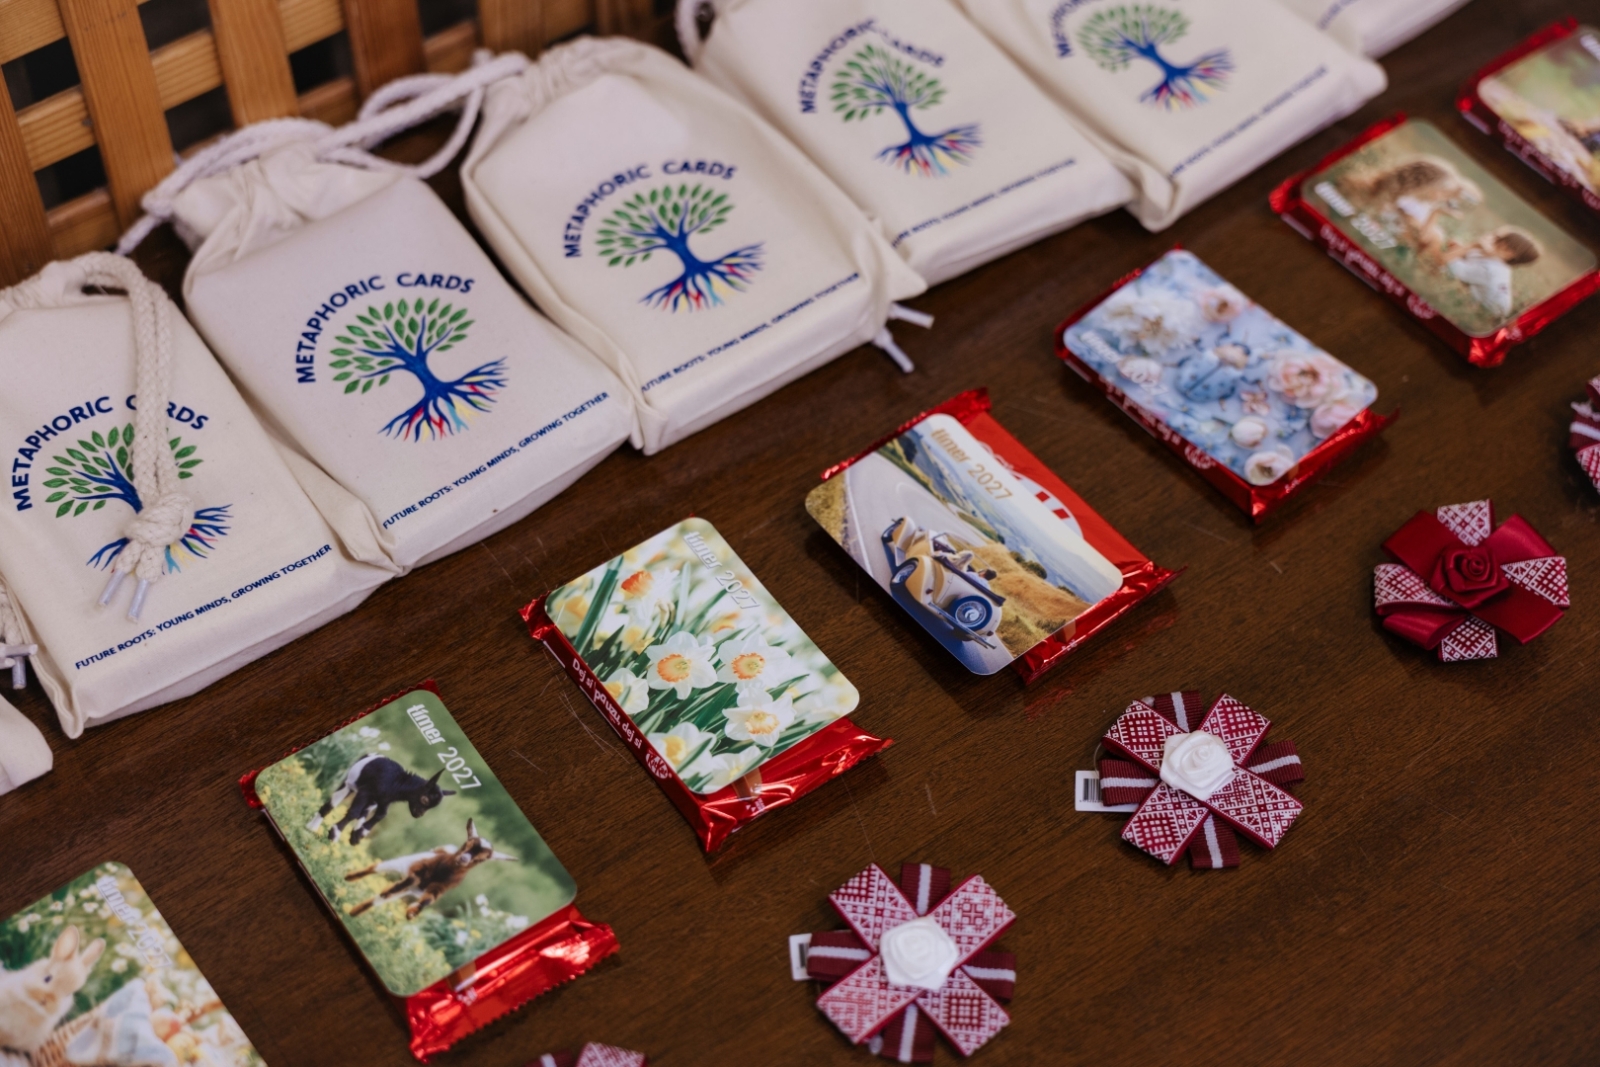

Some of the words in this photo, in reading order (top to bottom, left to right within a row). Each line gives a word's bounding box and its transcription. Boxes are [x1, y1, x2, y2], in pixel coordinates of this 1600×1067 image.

[564, 164, 652, 258] METAPHORIC
[662, 159, 737, 180] CARDS
[296, 276, 385, 383] METAPHORIC
[396, 272, 475, 294] CARDS
[641, 371, 672, 392] UTURE
[707, 339, 740, 357] YOUNG
[771, 297, 814, 324] GROWING
[12, 396, 113, 511] METAPHORIC
[126, 395, 209, 430] CRDS
[382, 505, 418, 529] FUTURE
[418, 485, 454, 507] ROOTS:
[452, 466, 487, 488] YOUNG
[486, 446, 520, 468] MINDS,
[518, 419, 563, 448] GROWING
[562, 391, 609, 422] TOGETHER
[967, 463, 1013, 500] 2027
[75, 647, 116, 670] FUTURE
[117, 629, 156, 651] ROOTS:
[156, 611, 195, 635] YOUNG
[195, 596, 232, 616] MINDS,
[231, 571, 281, 599] GROWING
[280, 544, 332, 575] TOGETHER
[715, 570, 760, 609] 2027
[572, 658, 587, 683] Dej
[585, 680, 594, 688] si
[593, 689, 621, 726] pauzu,
[622, 722, 635, 742] dej
[634, 737, 643, 749] si
[437, 746, 482, 789] 2027
[127, 923, 173, 968] 2027
